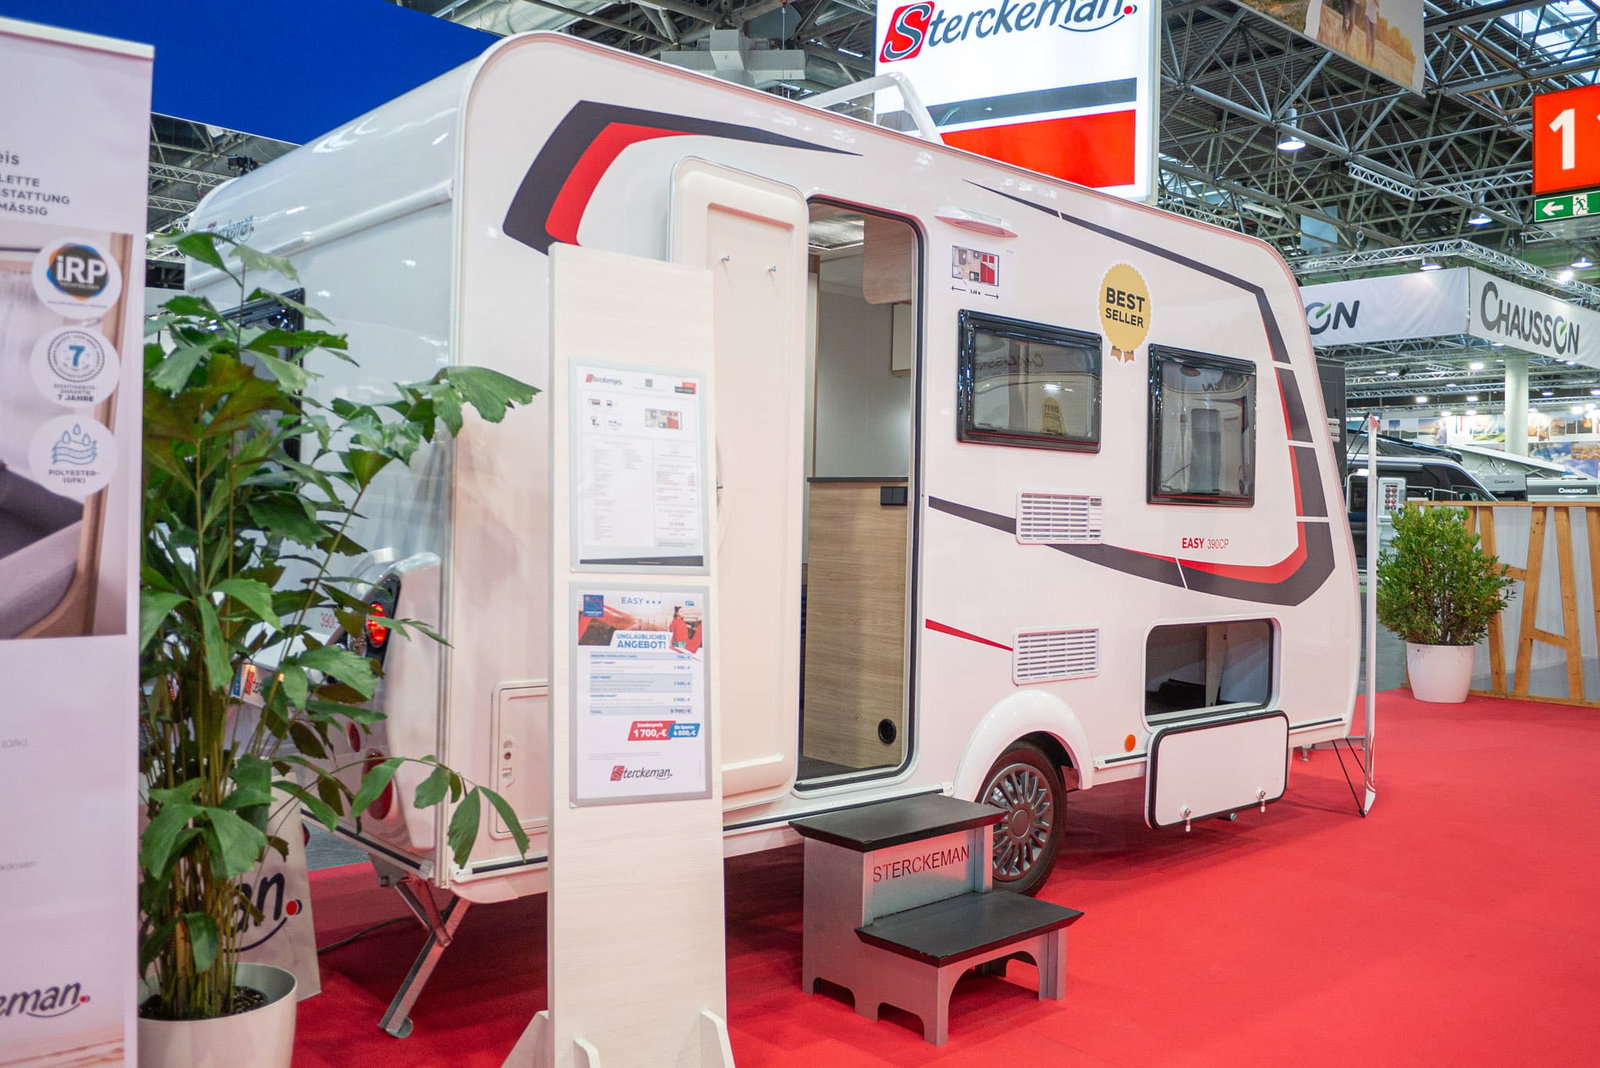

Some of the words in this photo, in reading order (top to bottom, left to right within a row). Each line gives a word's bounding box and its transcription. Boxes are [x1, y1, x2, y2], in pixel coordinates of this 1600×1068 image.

[56, 255, 107, 284] iRP
[1106, 287, 1146, 313] BEST
[1105, 308, 1144, 329] SELLER
[69, 345, 85, 367] 7
[1182, 537, 1204, 549] EASY
[621, 597, 644, 605] EASY
[617, 640, 667, 649] ANGEBOT!
[872, 845, 971, 883] STERCKEMAN
